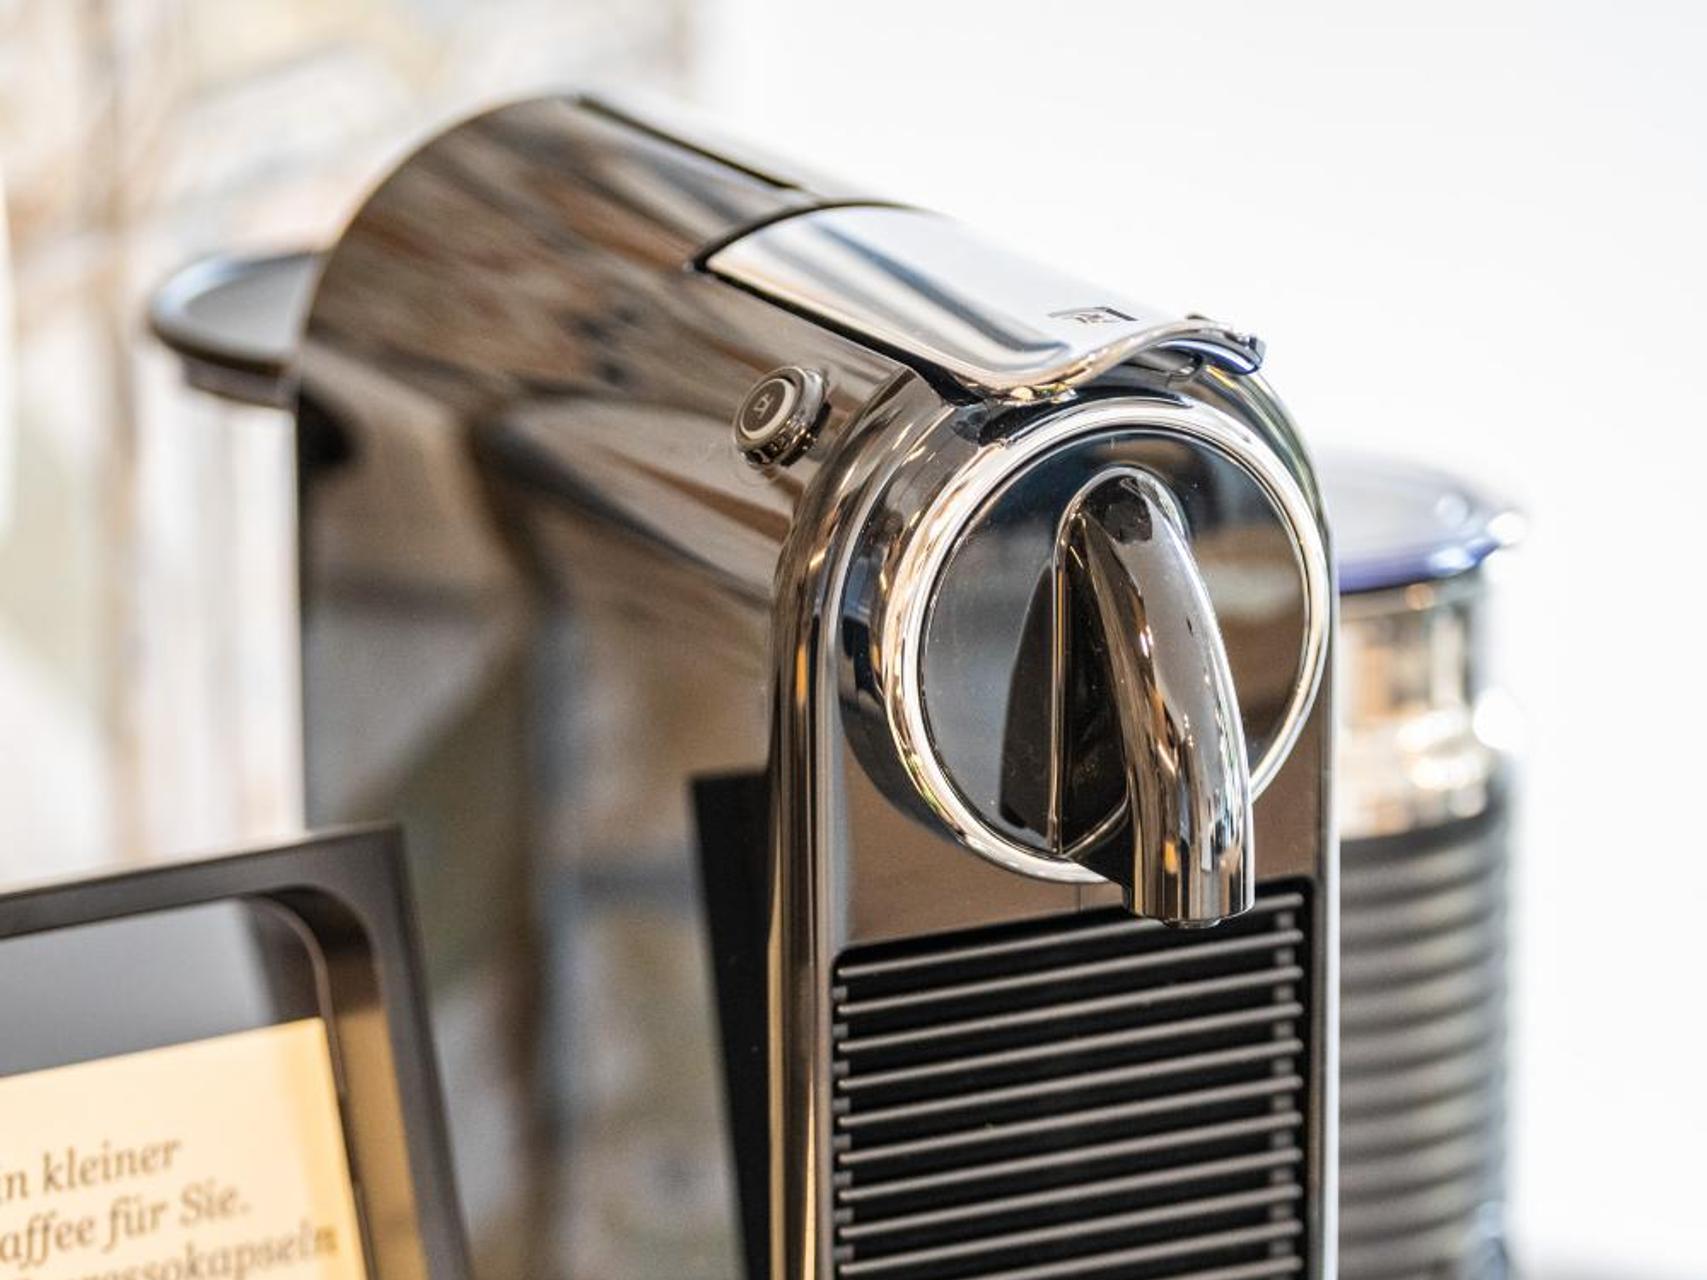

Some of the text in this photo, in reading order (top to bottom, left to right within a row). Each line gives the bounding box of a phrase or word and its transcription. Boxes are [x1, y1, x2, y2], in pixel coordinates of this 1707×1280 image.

[43, 1138, 181, 1193] kleiner
[0, 1176, 252, 1269] affee für Sie.
